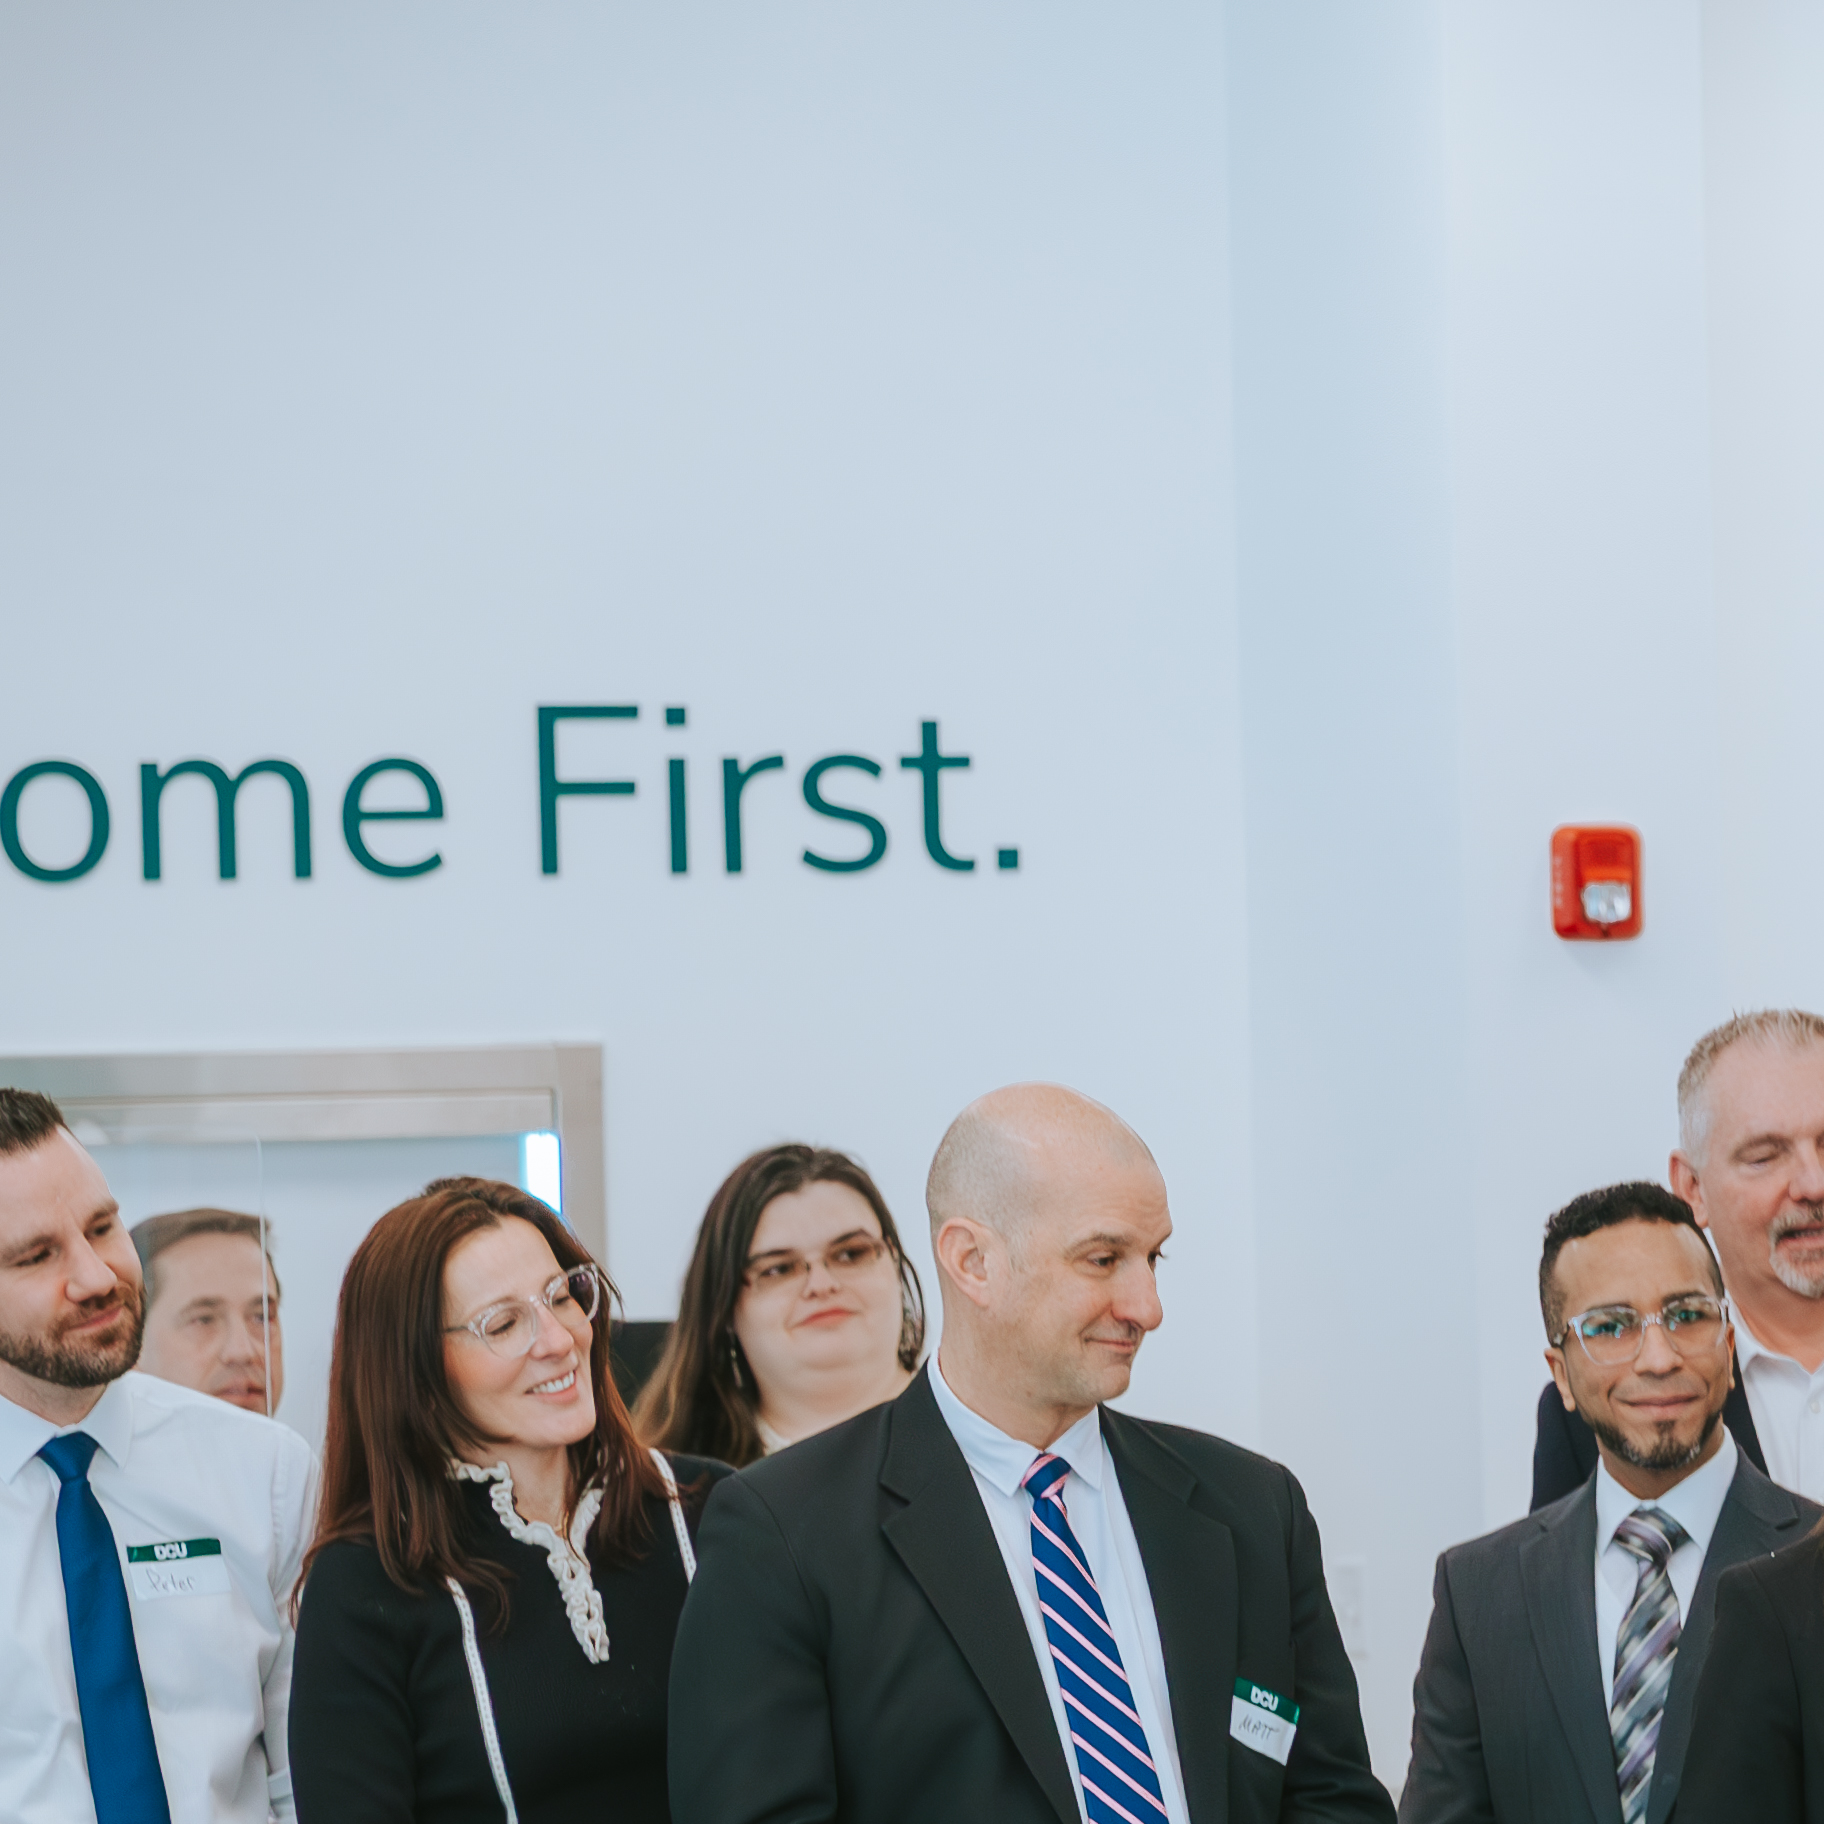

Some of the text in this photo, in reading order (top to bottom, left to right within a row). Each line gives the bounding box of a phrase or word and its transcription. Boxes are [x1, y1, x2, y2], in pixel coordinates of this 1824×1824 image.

[0, 704, 1020, 886] ome First.
[153, 1542, 188, 1561] DCU
[1250, 1684, 1279, 1712] DCU
